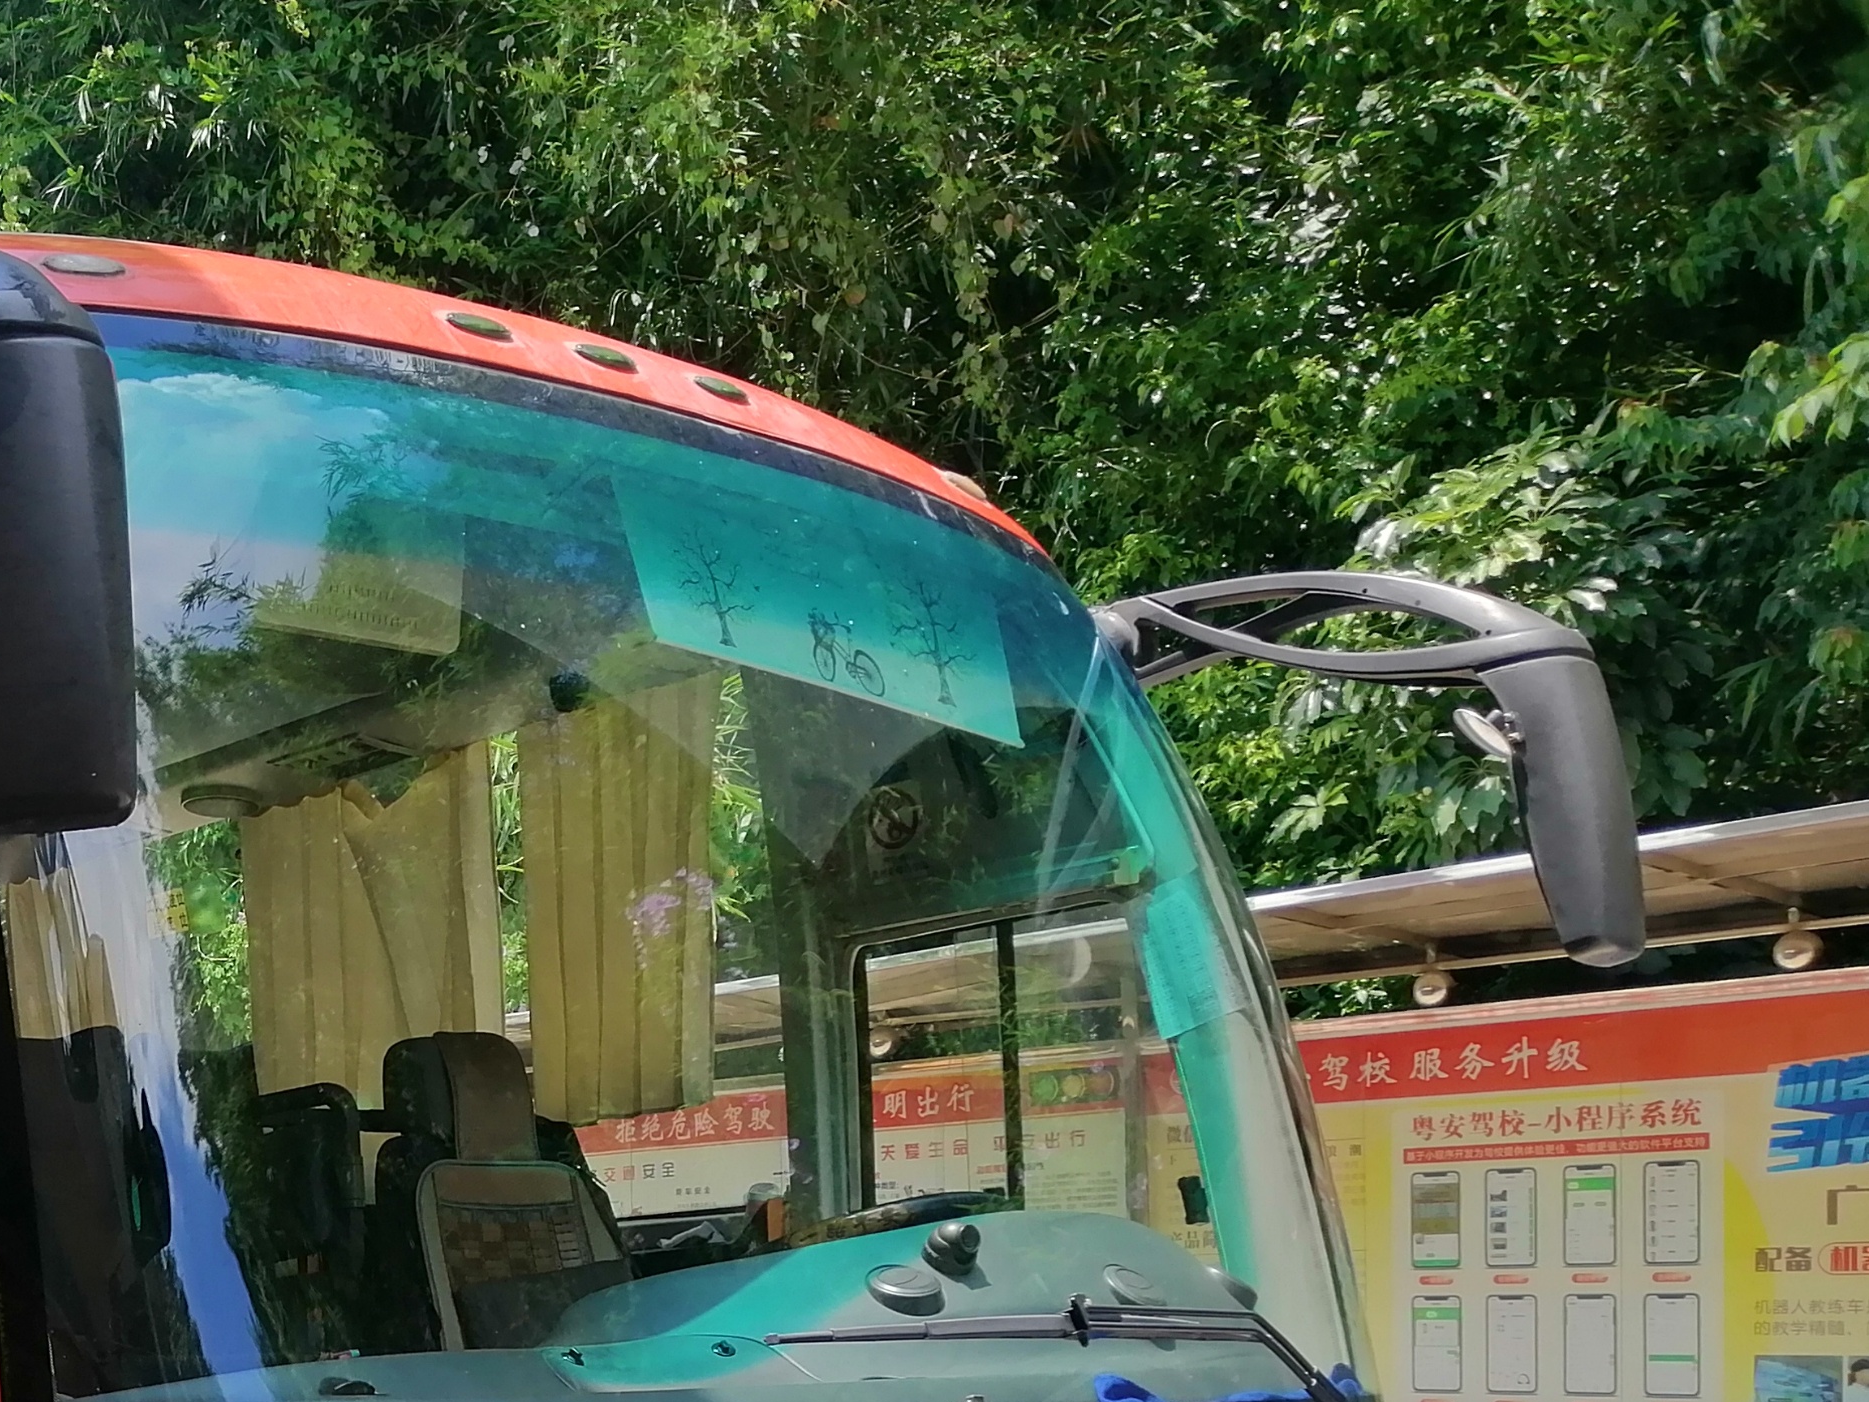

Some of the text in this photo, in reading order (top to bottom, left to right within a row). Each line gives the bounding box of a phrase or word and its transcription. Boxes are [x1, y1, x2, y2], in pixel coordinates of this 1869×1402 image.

[1305, 1036, 1588, 1091] 驾校 服务升级
[873, 1083, 975, 1122] 明出行
[1412, 1098, 1703, 1141] 粤安驾校-小程序系统
[615, 1101, 775, 1144] 拒绝危险驾驶
[590, 1162, 676, 1183] 交通安全
[1755, 1246, 1869, 1272] 配备 机
[1754, 1299, 1869, 1314] 机器人教练车
